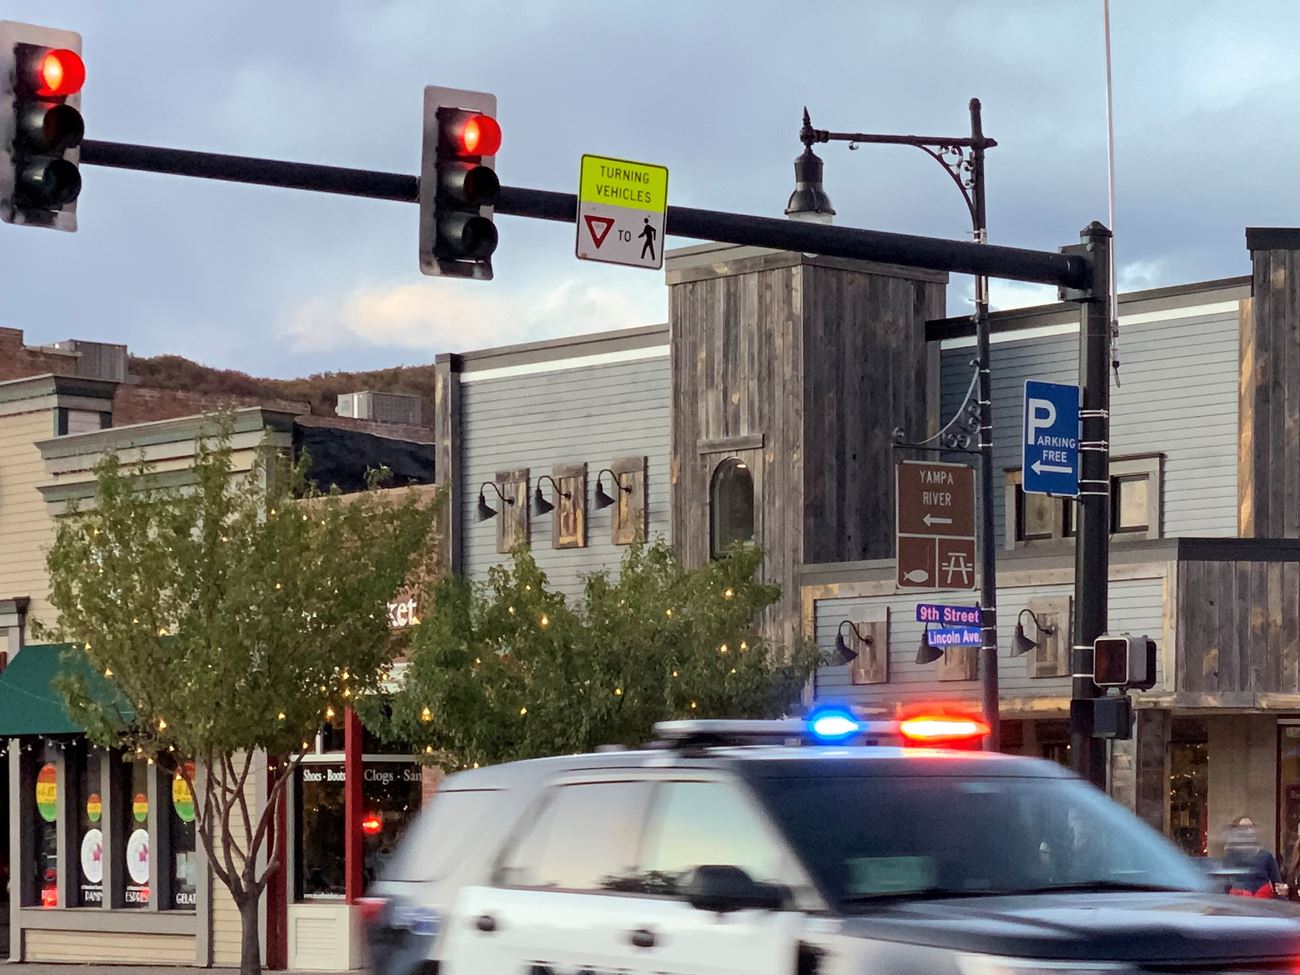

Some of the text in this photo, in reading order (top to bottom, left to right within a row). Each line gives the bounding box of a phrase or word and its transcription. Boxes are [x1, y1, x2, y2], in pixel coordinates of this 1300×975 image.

[600, 165, 650, 184] TURNING
[596, 184, 652, 204] VEHICLES
[618, 229, 632, 243] TO
[1042, 449, 1068, 463] FREE
[920, 470, 954, 485] YAMPA
[923, 491, 952, 507] RIVER
[920, 606, 980, 623] 9th Street
[928, 629, 982, 645] Lincoln Ave.
[303, 769, 322, 782] Shoes
[327, 769, 346, 782] Boots
[364, 769, 394, 785] Clogs
